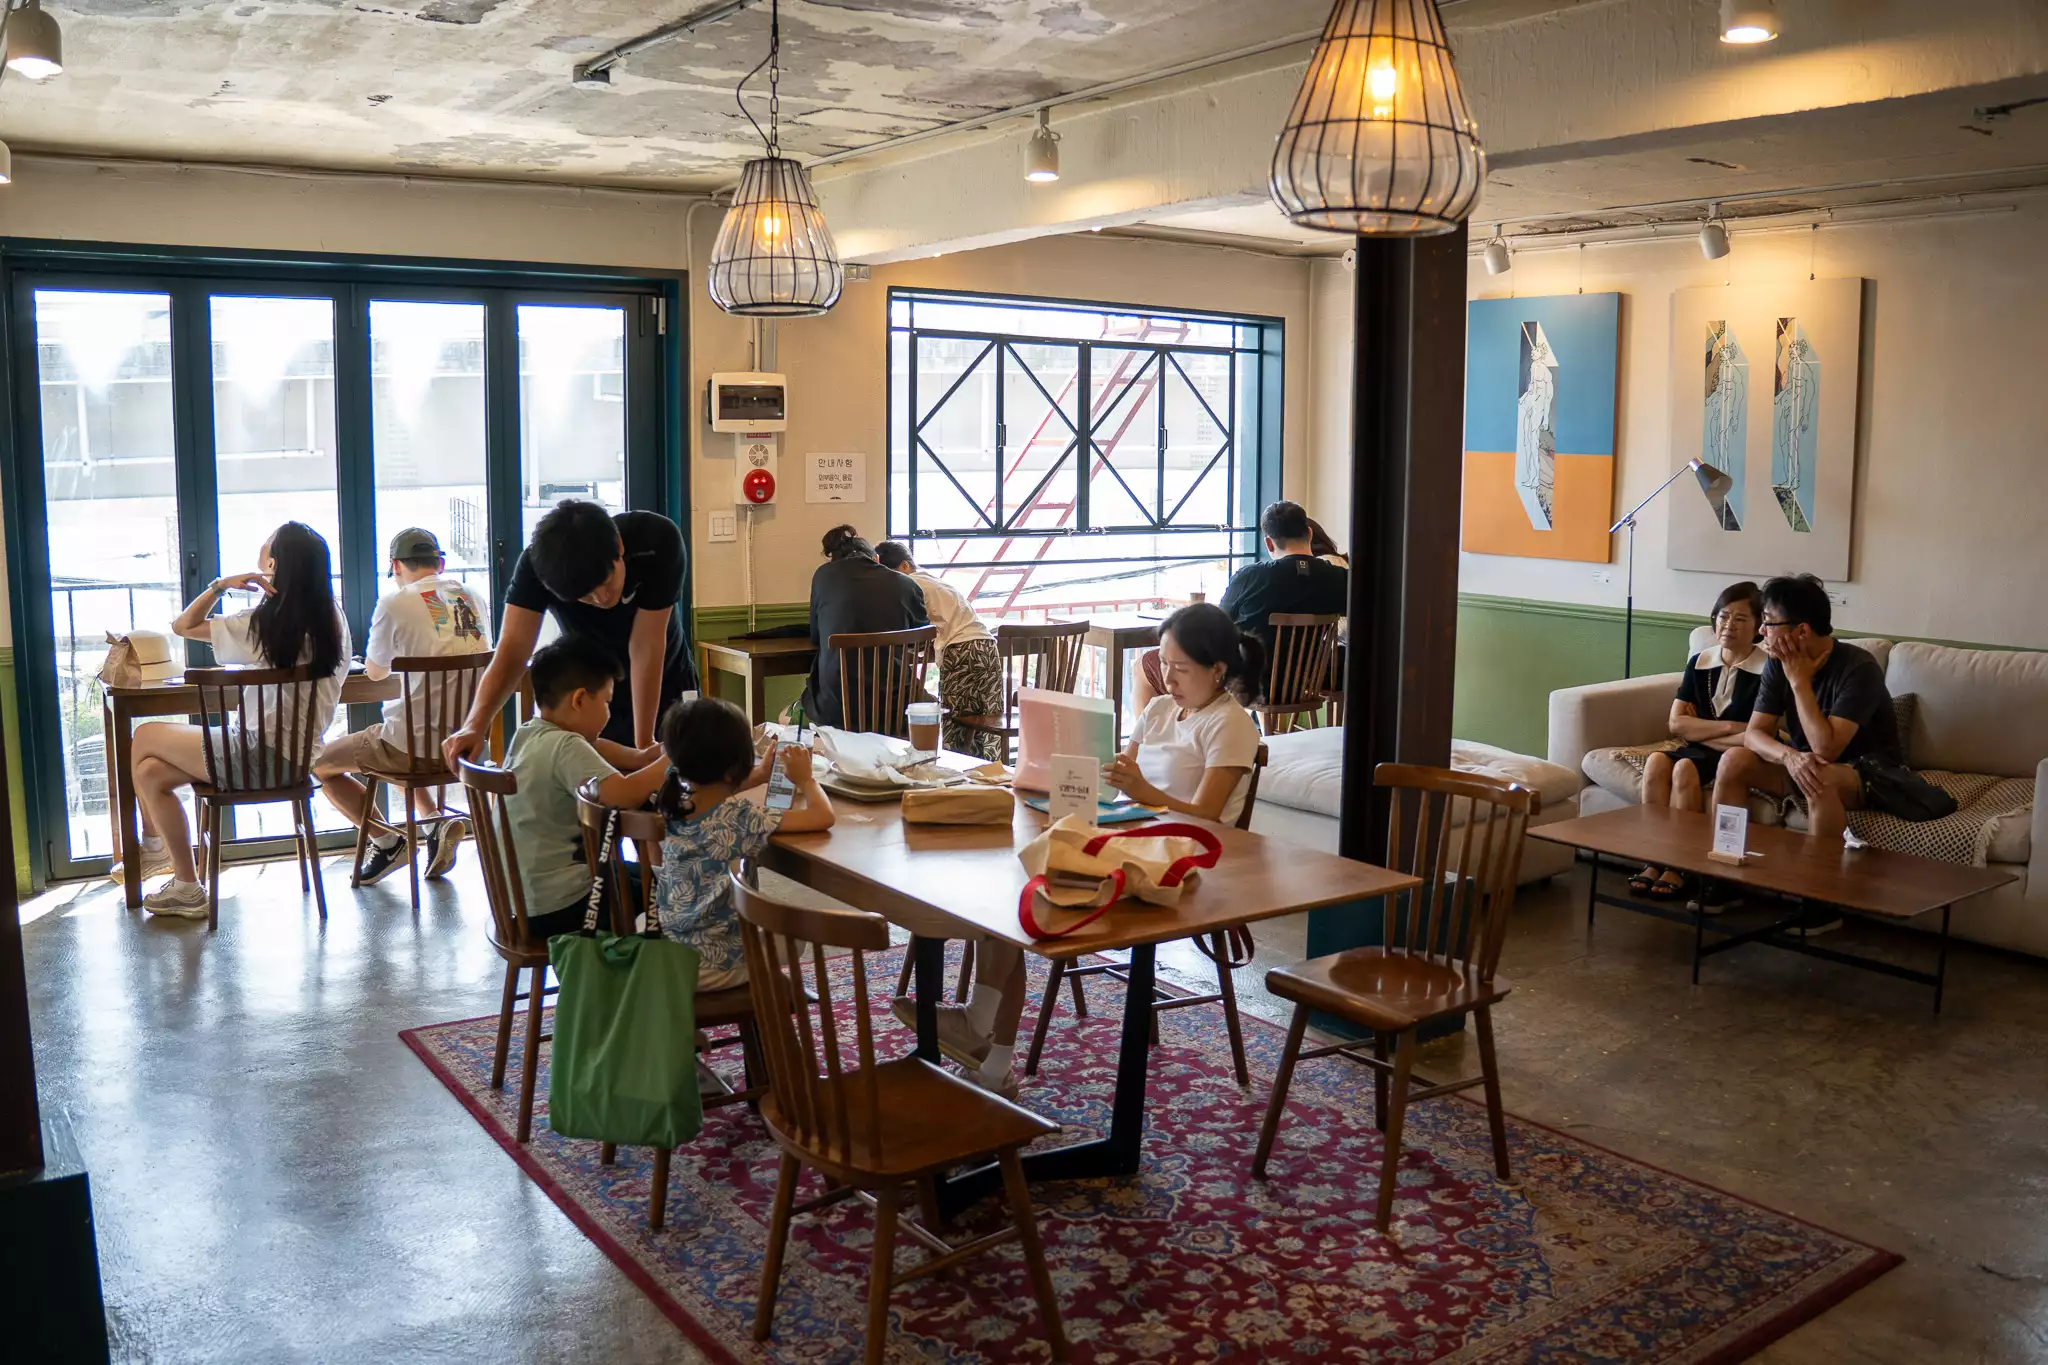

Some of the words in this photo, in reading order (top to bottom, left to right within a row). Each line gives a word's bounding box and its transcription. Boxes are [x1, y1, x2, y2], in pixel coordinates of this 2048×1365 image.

[818, 458, 853, 468] 안내사항
[598, 809, 618, 863] NAVER
[583, 876, 604, 930] NAVER
